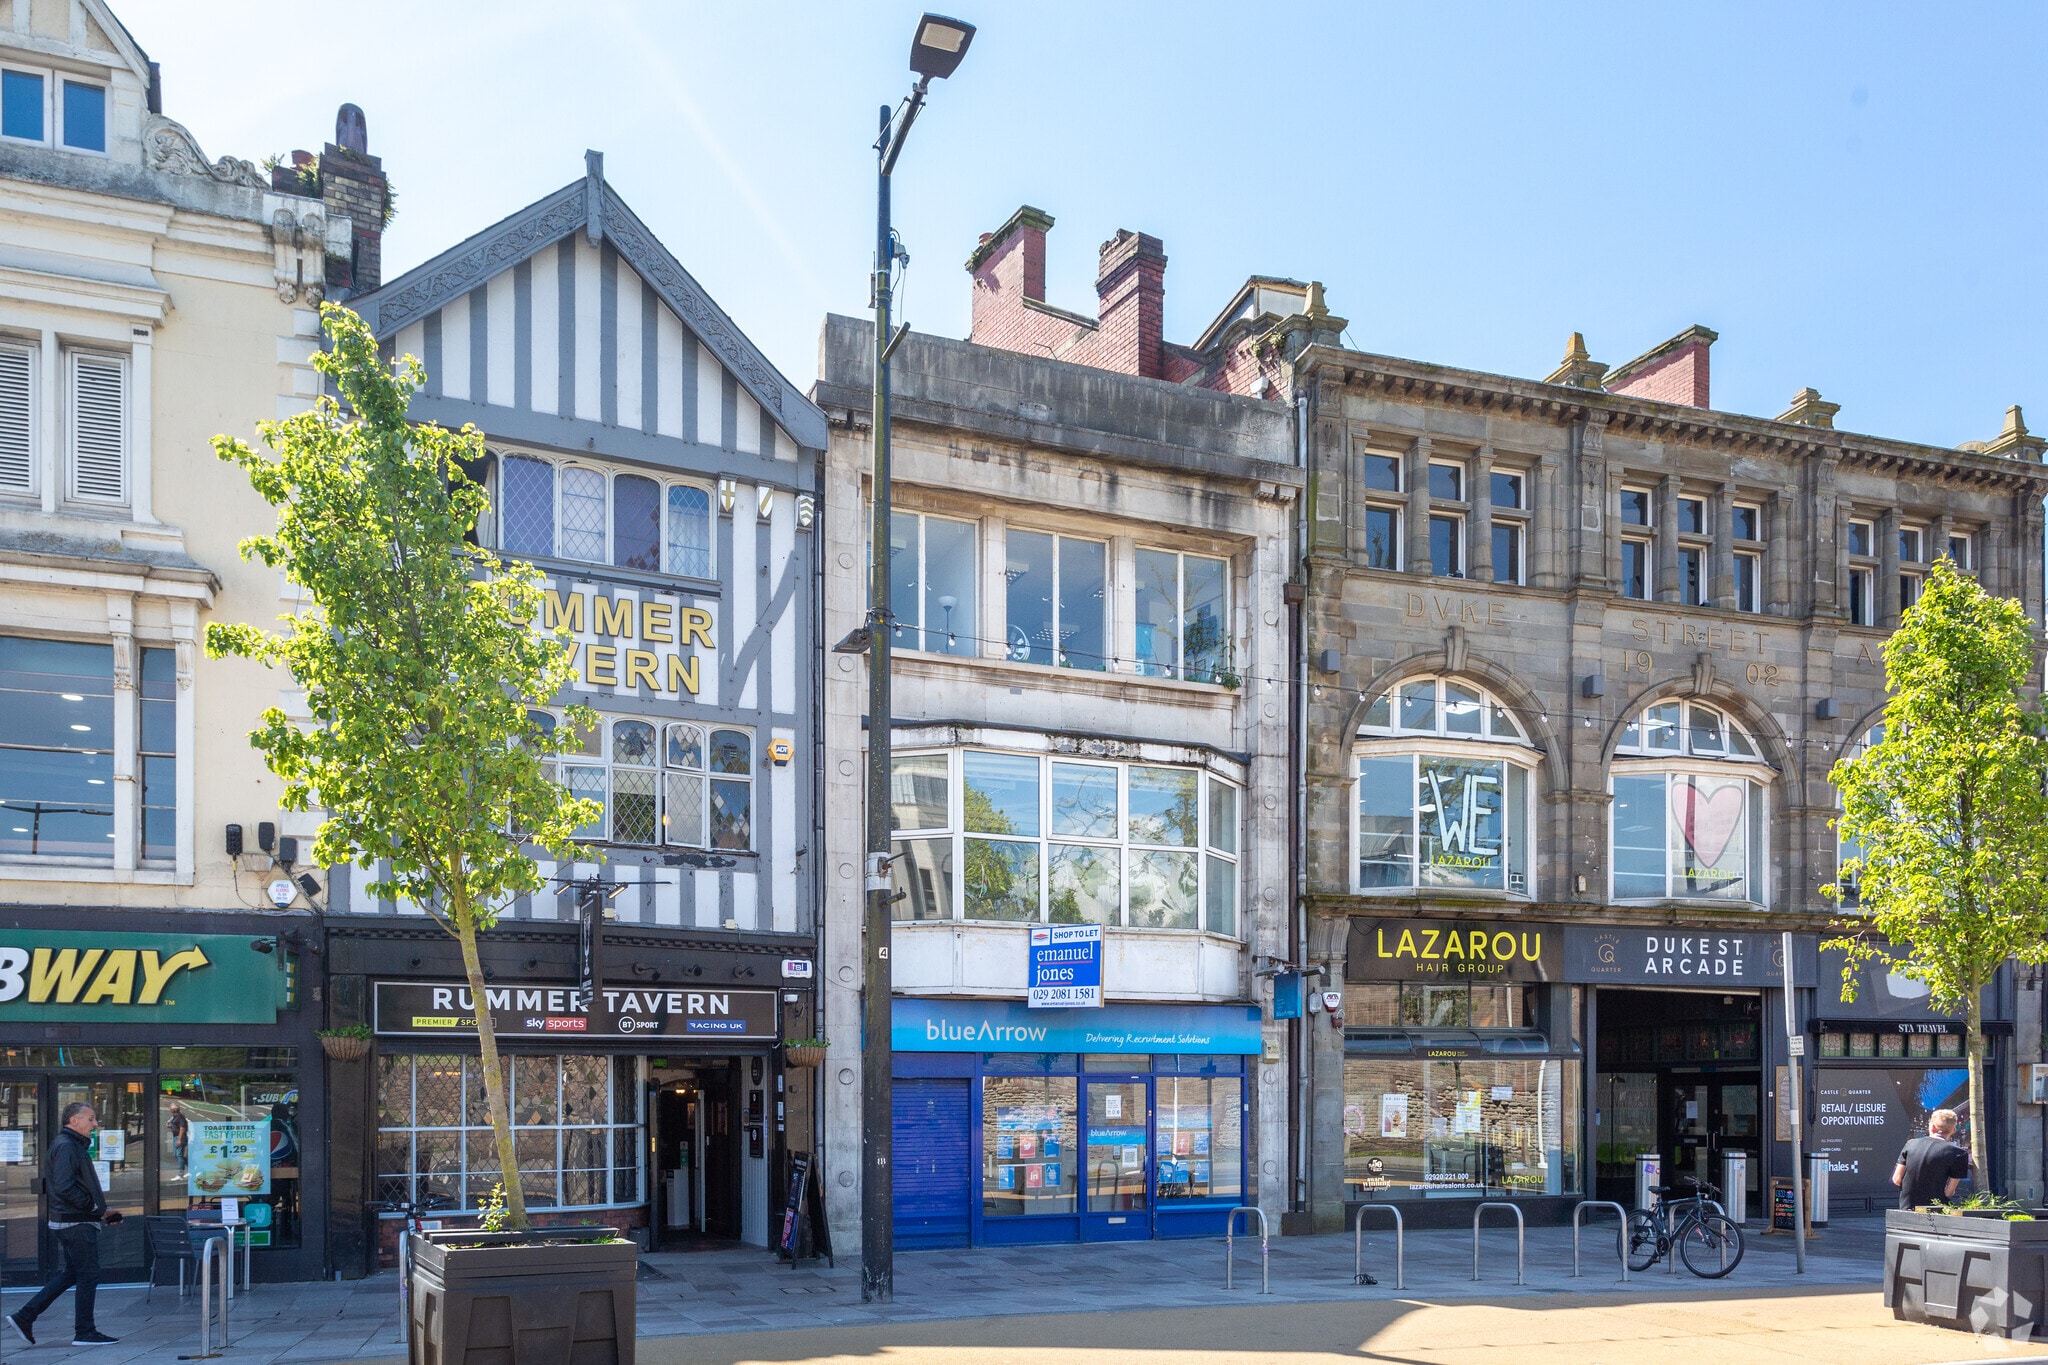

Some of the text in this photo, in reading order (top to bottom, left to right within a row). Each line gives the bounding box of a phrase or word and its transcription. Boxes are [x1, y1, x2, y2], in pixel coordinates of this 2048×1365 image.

[497, 586, 717, 648] UMMER
[1407, 593, 1771, 655] DVKE STREET
[1623, 651, 1781, 687] 19 02
[776, 745, 788, 753] ADT
[1428, 768, 1498, 856] WE
[1431, 855, 1491, 869] LAZAROU
[1681, 866, 1735, 880] LAZAROU
[1054, 929, 1098, 939] SHOP TO LET
[1037, 941, 1093, 962] emanuel
[1377, 928, 1541, 962] LAZAROU
[1646, 936, 1710, 955] DUKE
[880, 948, 887, 958] 4
[1416, 963, 1504, 973] HAIR GROUP
[1644, 957, 1743, 976] ARCADE
[1036, 965, 1074, 987] jones
[1033, 988, 1095, 1000] 029 2081 1581
[602, 992, 729, 1015] TAVERN
[416, 1018, 453, 1026] PREMIER
[526, 1017, 545, 1030] sky
[547, 1018, 585, 1029] sports
[622, 1020, 633, 1029] BT
[636, 1021, 659, 1030] SPORT
[1898, 1024, 1949, 1034] STA TRAVEL
[926, 1019, 1047, 1043] blueArrow
[1085, 1033, 1211, 1048] Delivering Recruitment Solutions
[1821, 1103, 1847, 1113] RETAIL
[1855, 1103, 1887, 1113] LEISURE
[1821, 1115, 1885, 1126] OPPORTUNITIES
[204, 1130, 256, 1139] TASTY PRICE
[1090, 1129, 1127, 1137] blueArrow
[1501, 1175, 1544, 1185] LAZAROU
